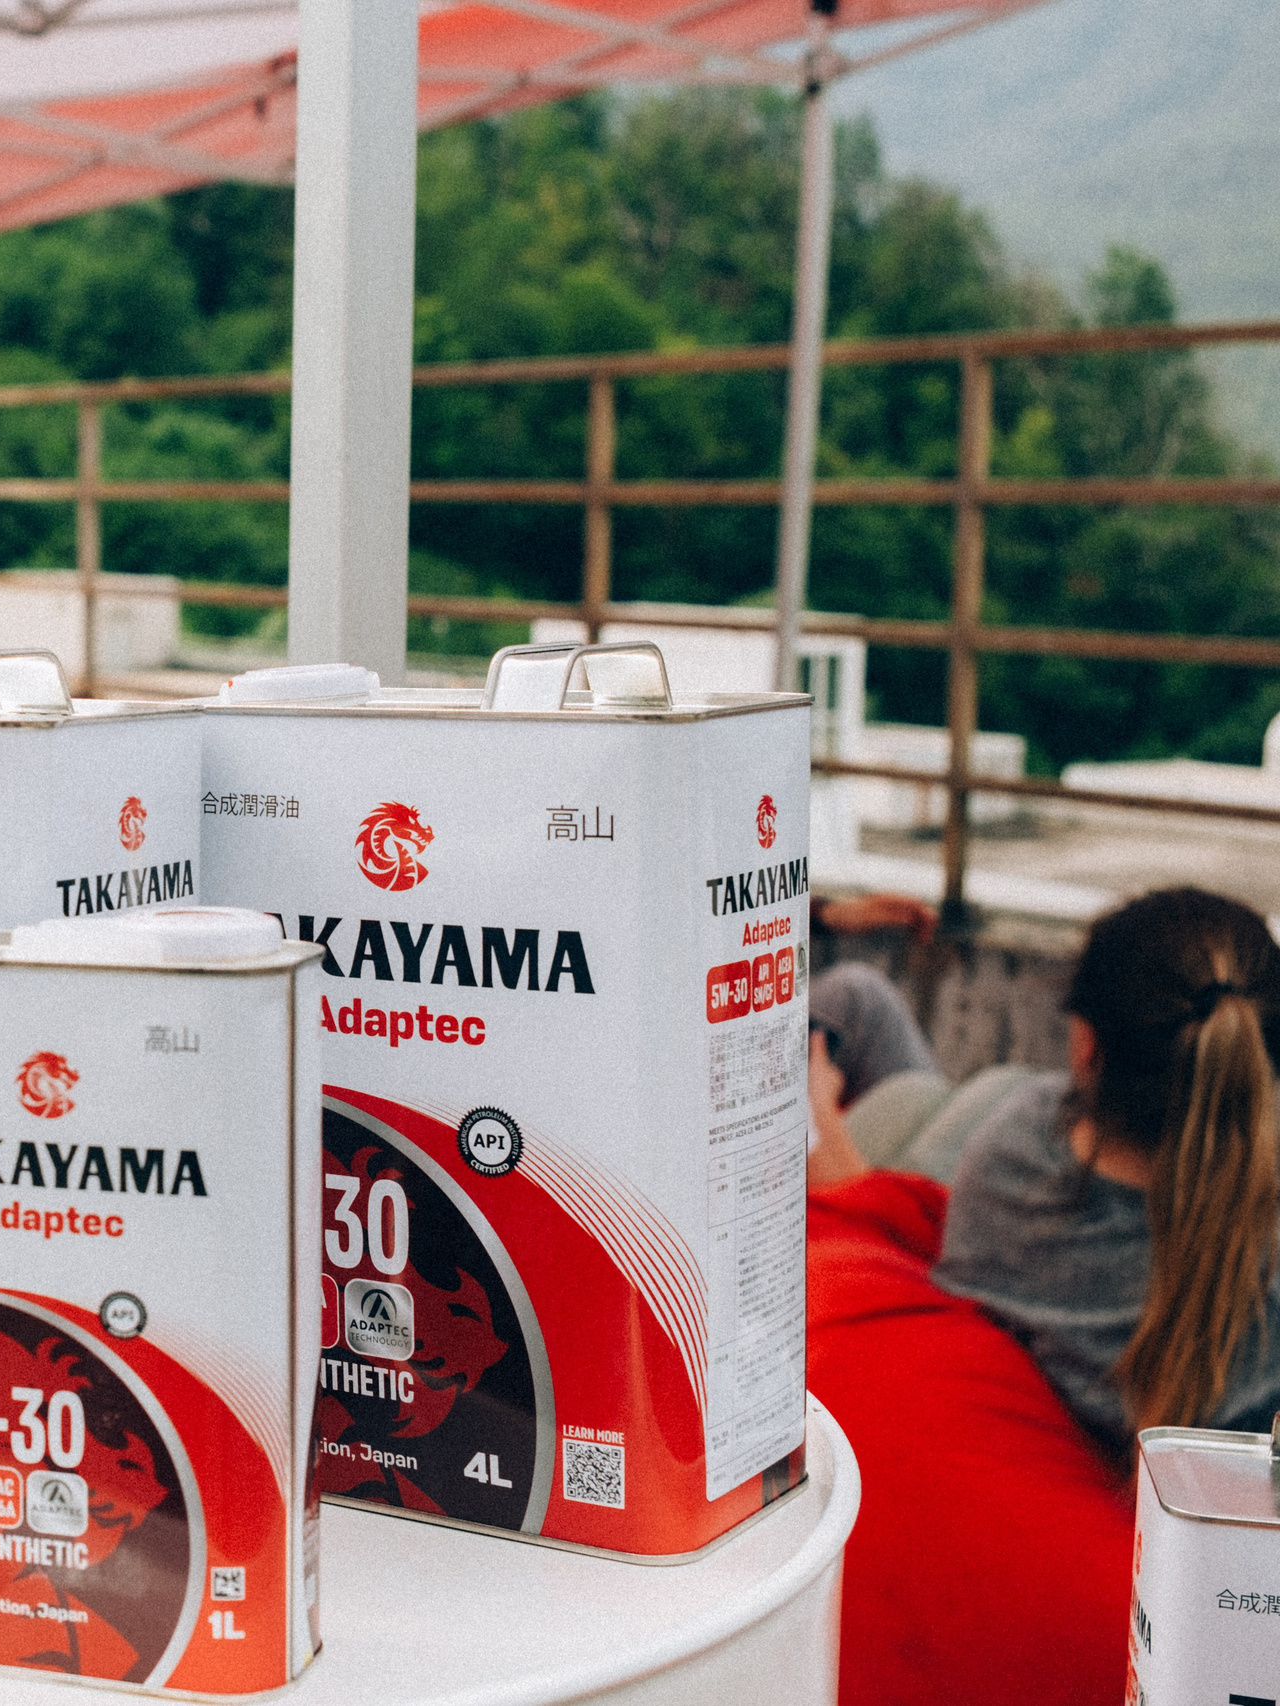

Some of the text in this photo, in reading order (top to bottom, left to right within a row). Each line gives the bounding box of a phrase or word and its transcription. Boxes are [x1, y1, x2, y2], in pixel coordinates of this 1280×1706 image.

[200, 791, 299, 818] 合成潤滑油
[545, 805, 615, 842] 高山
[56, 860, 194, 917] TAKAYAMA
[706, 856, 809, 917] TAKAYAMA
[742, 915, 791, 947] Adaptec
[263, 912, 596, 995] KAYAMA
[711, 977, 748, 1009] 5W-30
[471, 1110, 509, 1125] PETROLEUM
[473, 1132, 505, 1150] API
[470, 1159, 510, 1175] CERTIFIED
[350, 1319, 410, 1337] ADAPTEC
[351, 1332, 410, 1348] TECHNOLOGY
[563, 1424, 625, 1445] LEARN MORE
[360, 1443, 418, 1471] Japan
[463, 1451, 513, 1489] 4L
[36, 1602, 89, 1623] Japan
[208, 1611, 246, 1640] 1L
